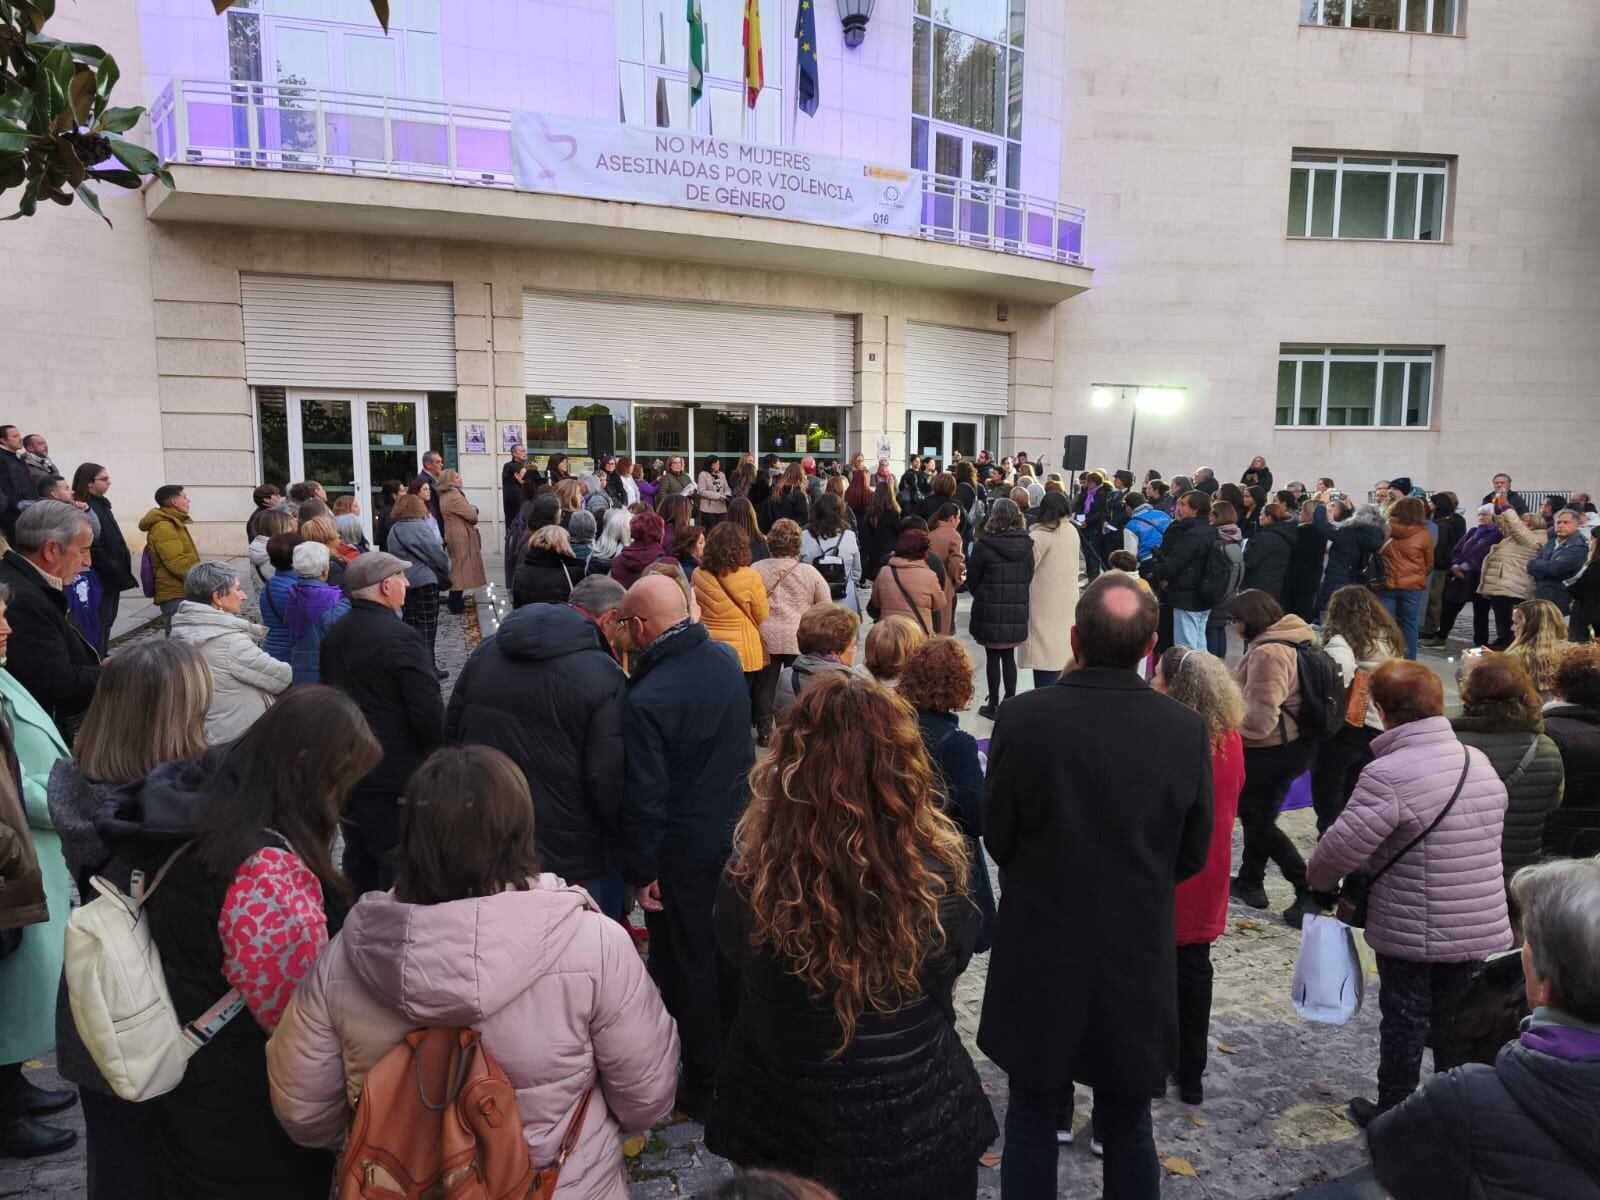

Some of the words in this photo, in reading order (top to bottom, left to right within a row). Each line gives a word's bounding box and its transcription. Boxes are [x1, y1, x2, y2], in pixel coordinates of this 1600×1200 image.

[655, 135, 685, 153] NO
[690, 137, 729, 159] MÁS
[739, 145, 811, 172] MUJERES
[595, 153, 720, 180] ASESINADAS
[725, 166, 762, 186] POR
[767, 172, 854, 202] VIOLENCIA
[686, 183, 710, 202] DE
[715, 186, 785, 211] GÉNERO
[873, 212, 889, 225] 016
